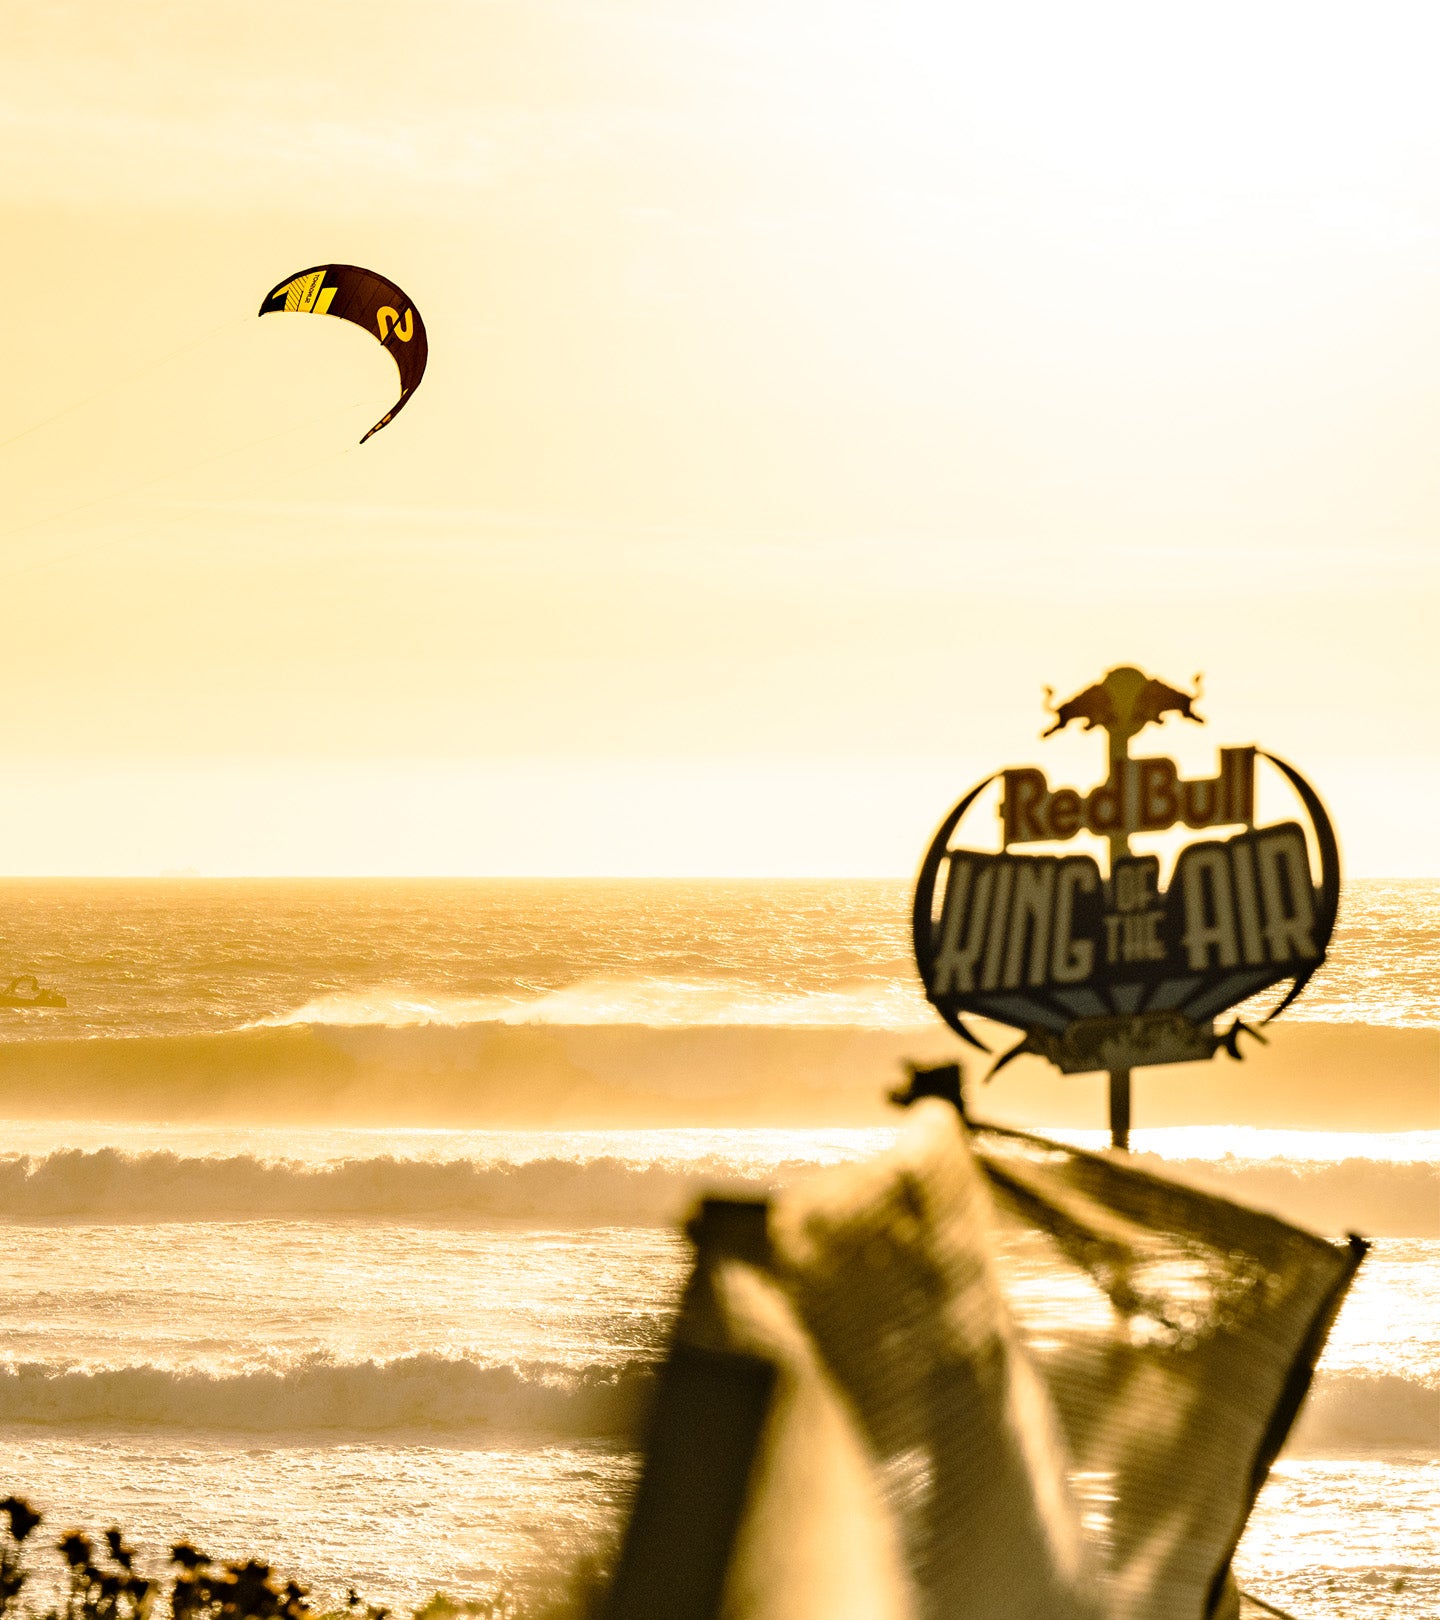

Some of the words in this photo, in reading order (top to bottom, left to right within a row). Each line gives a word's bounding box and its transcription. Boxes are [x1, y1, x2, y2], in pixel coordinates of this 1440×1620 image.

[1006, 760, 1124, 841] Red
[1139, 748, 1255, 829] Bull
[932, 860, 1097, 995] KING
[1115, 862, 1156, 911] OF
[1182, 833, 1317, 971] AIR
[1103, 911, 1167, 963] THE
